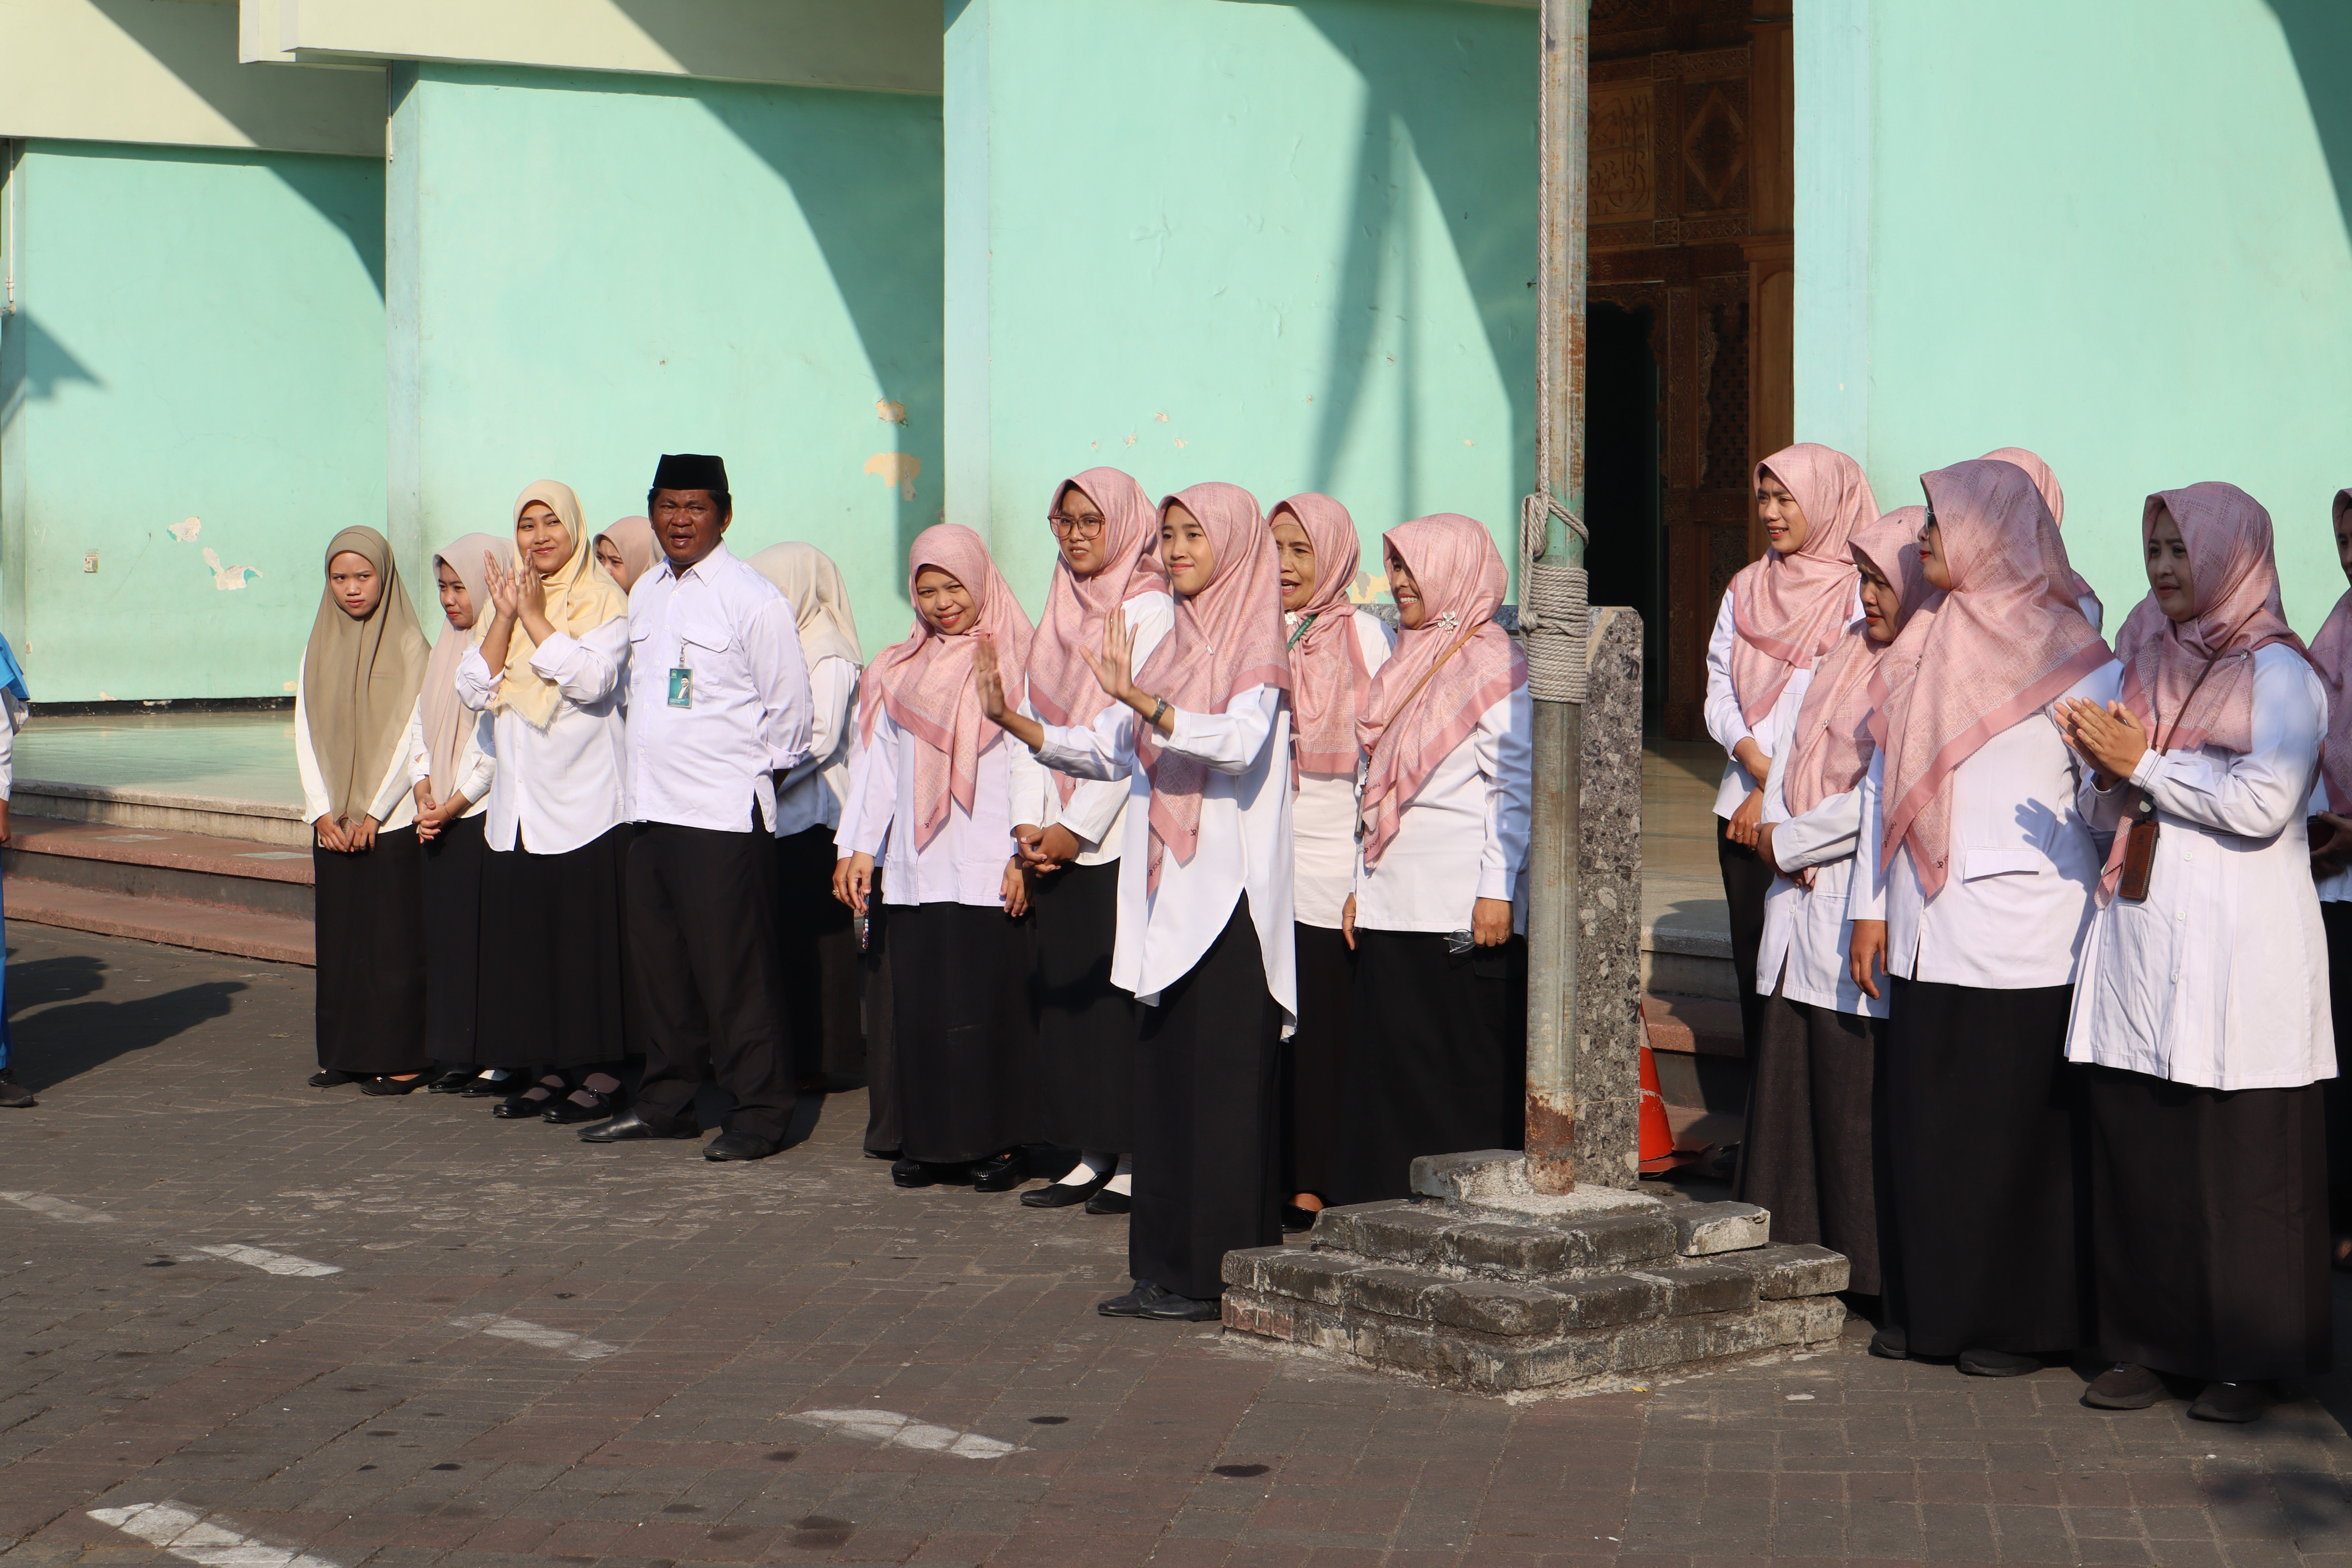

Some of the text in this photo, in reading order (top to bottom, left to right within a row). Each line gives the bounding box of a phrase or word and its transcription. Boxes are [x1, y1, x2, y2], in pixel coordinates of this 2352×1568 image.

[1448, 666, 1498, 722] JOURNEY
[2004, 647, 2070, 701] JOURNEY
[909, 701, 954, 731] JOURNEY
[1342, 671, 1355, 739] JOURNEY
